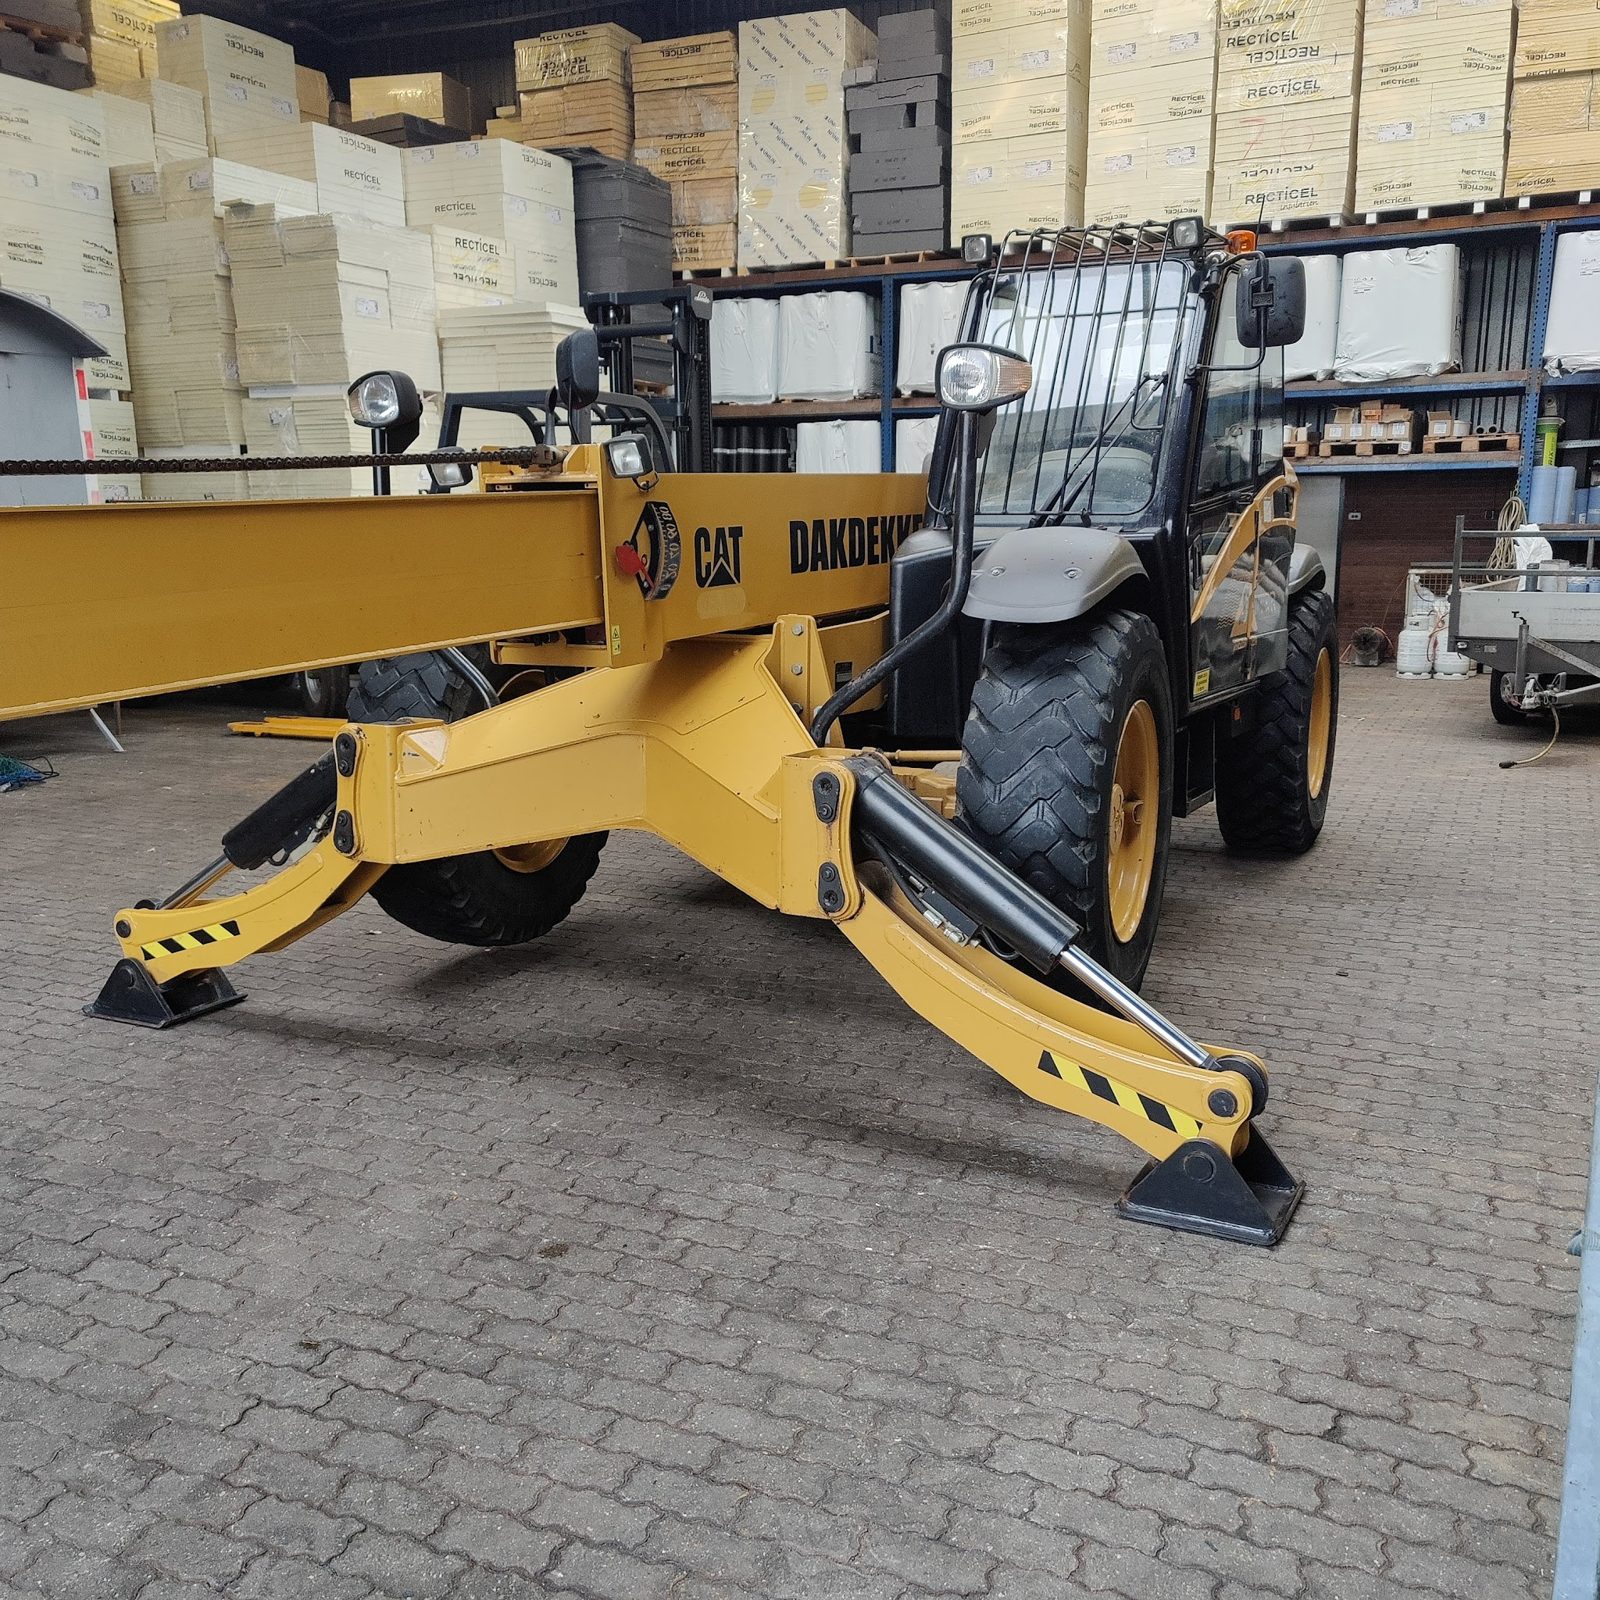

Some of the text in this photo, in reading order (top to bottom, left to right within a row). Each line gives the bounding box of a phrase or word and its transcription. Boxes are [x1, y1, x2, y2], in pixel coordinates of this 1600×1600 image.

[112, 11, 154, 34] ECTICEL
[1226, 30, 1298, 48] RECTICEL
[225, 39, 264, 58] RECTICEL
[660, 45, 701, 58] RECTICEL
[1246, 46, 1320, 63] RECTICEL
[1247, 79, 1321, 99] RECTICEL
[1171, 94, 1206, 102] RECTICEL
[1100, 102, 1135, 113] RECTICEL
[338, 135, 377, 154] RECTICEL
[660, 145, 702, 154] RECTICEL
[521, 153, 552, 168] RECTICEL
[664, 157, 706, 167] RECTICEL
[344, 169, 381, 185] RECTICEL
[1245, 187, 1318, 205] RECTICEL
[434, 201, 476, 213] RECTICEL
[455, 237, 500, 256] RECTICEL
[659, 506, 673, 520] 80
[694, 526, 743, 588] CAT
